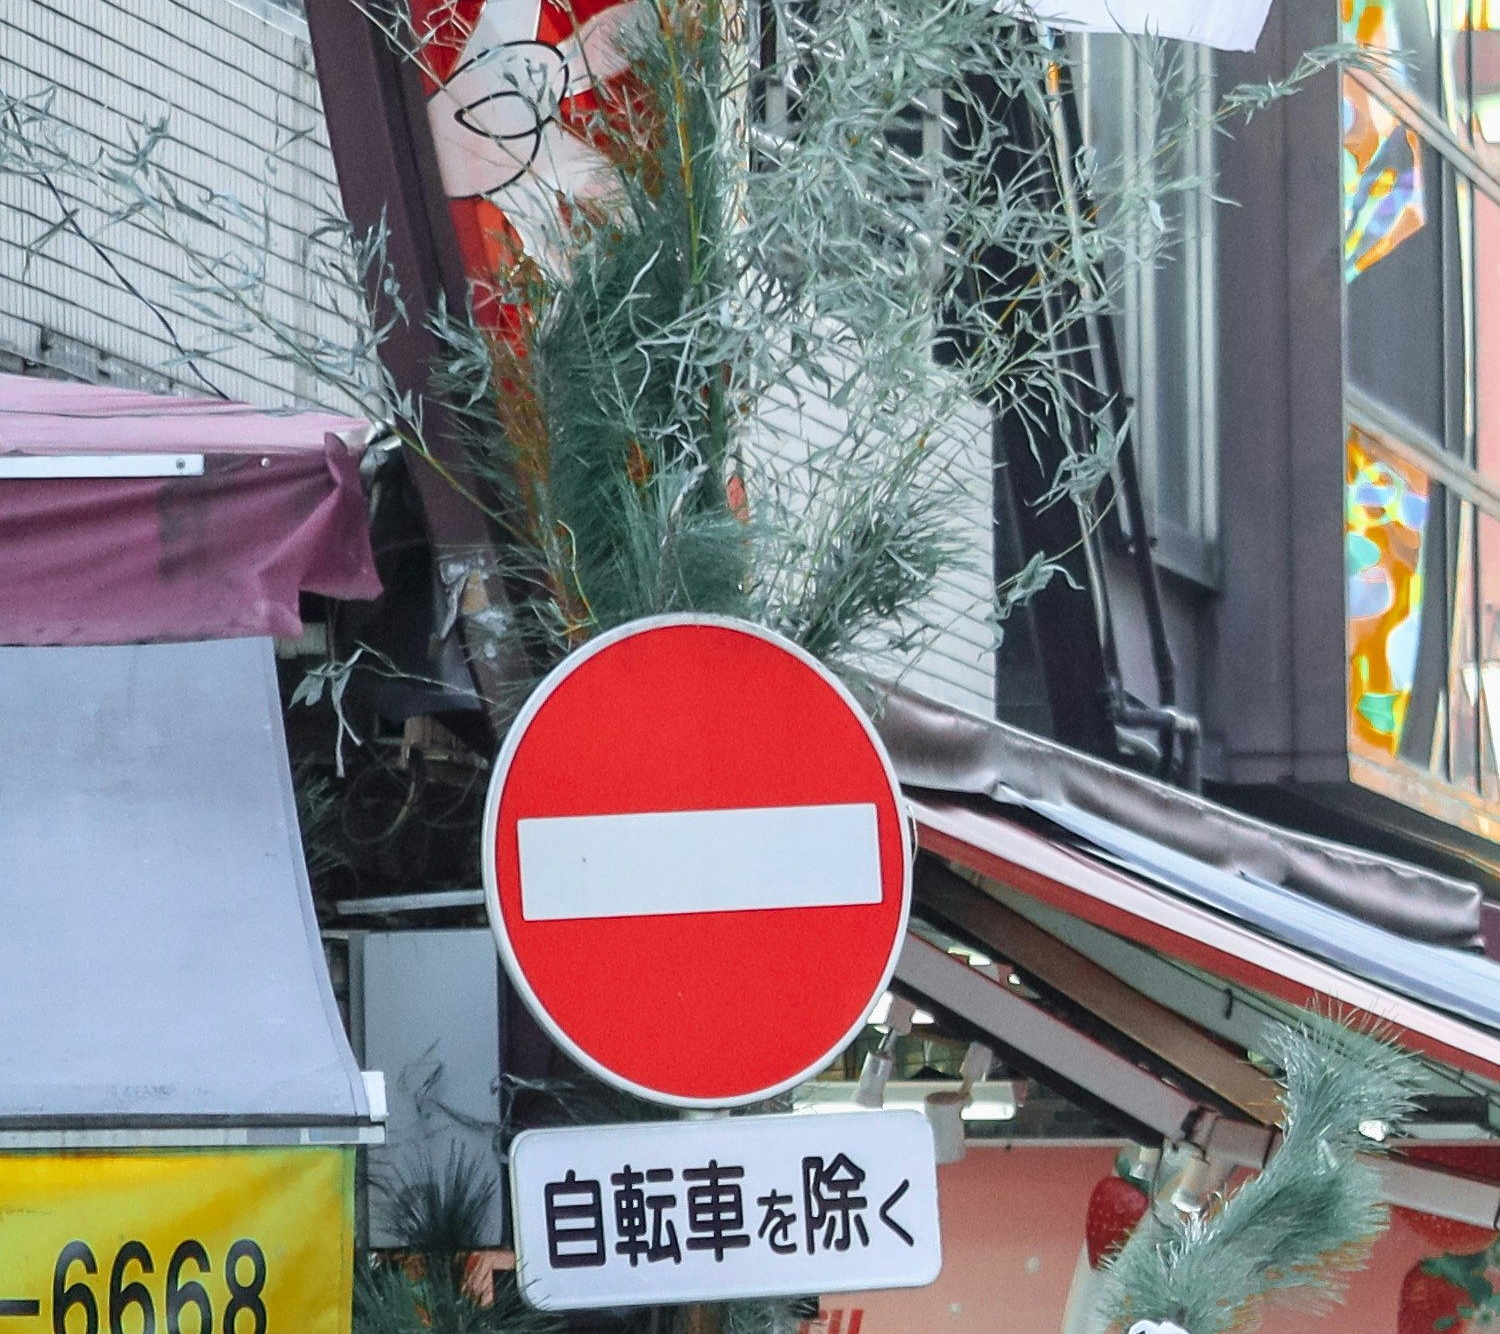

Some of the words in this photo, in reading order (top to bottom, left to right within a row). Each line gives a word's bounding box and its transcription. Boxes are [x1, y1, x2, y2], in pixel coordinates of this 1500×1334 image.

[543, 1152, 916, 1269] 自転車を除く
